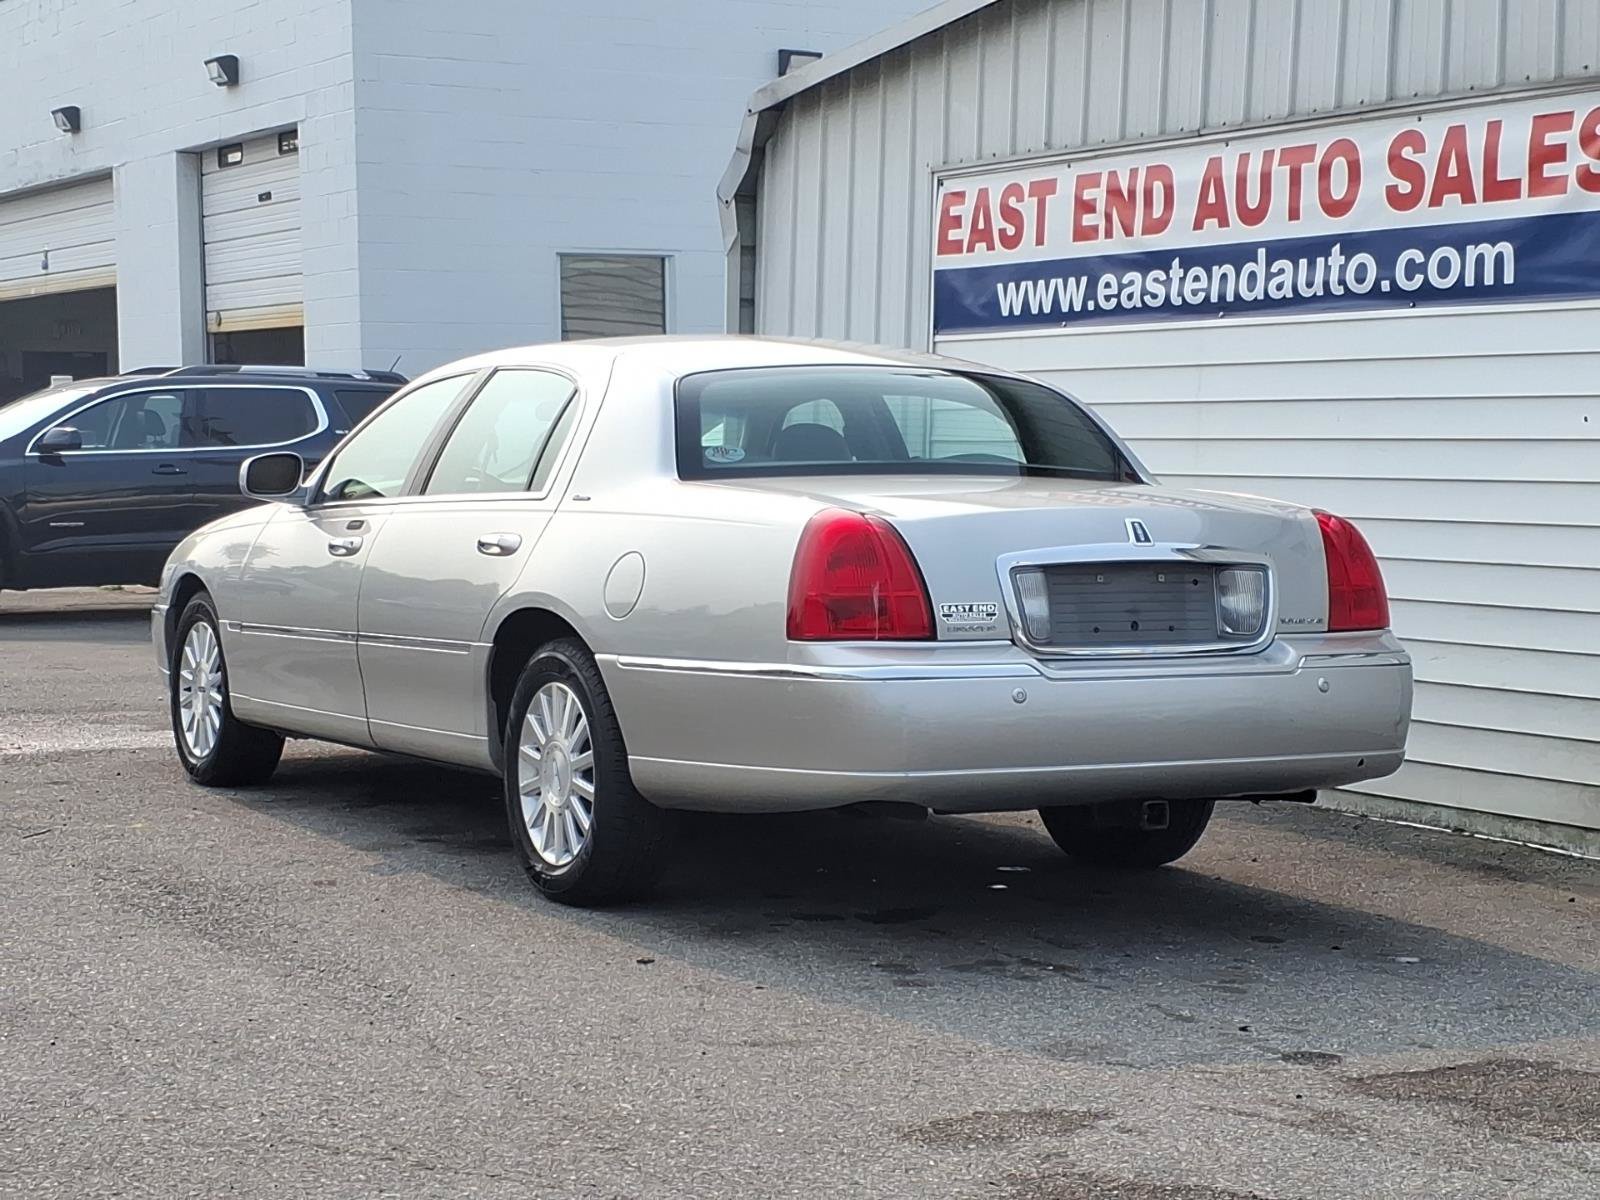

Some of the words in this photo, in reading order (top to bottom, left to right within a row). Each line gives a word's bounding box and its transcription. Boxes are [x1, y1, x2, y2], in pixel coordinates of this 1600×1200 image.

[936, 178, 1058, 256] EAST
[1071, 163, 1176, 243] END
[1191, 137, 1362, 232] AUTO
[996, 240, 1516, 318] www.eastendauto.com
[943, 604, 970, 613] EAST
[972, 603, 995, 612] END
